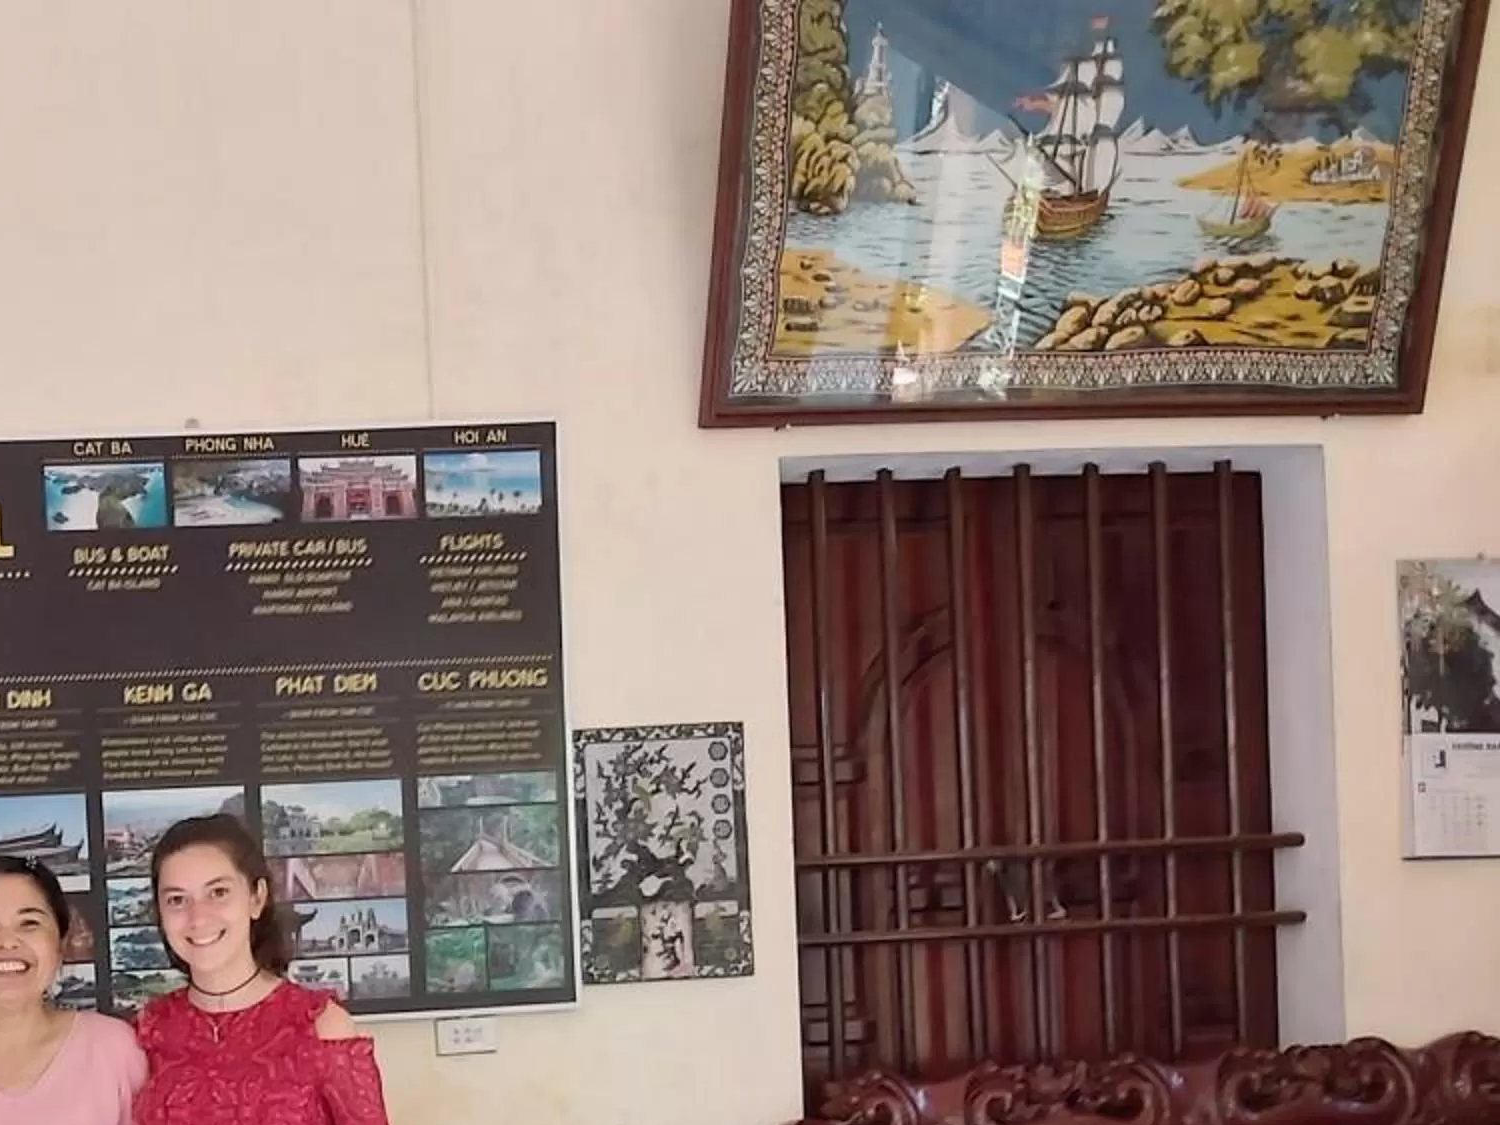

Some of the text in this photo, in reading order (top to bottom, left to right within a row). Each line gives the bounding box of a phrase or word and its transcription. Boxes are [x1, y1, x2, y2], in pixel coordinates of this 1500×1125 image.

[185, 437, 275, 452] PHONG NHA
[454, 429, 507, 444] HOI AN
[73, 440, 133, 456] CAT BA
[440, 532, 504, 552] FLIGHTS
[73, 547, 107, 565] BUS
[127, 544, 169, 562] BOAT
[275, 675, 324, 695] PHAT
[418, 668, 548, 691] CUC PHUONG
[7, 689, 51, 709] DINH
[124, 682, 212, 704] KENH GA
